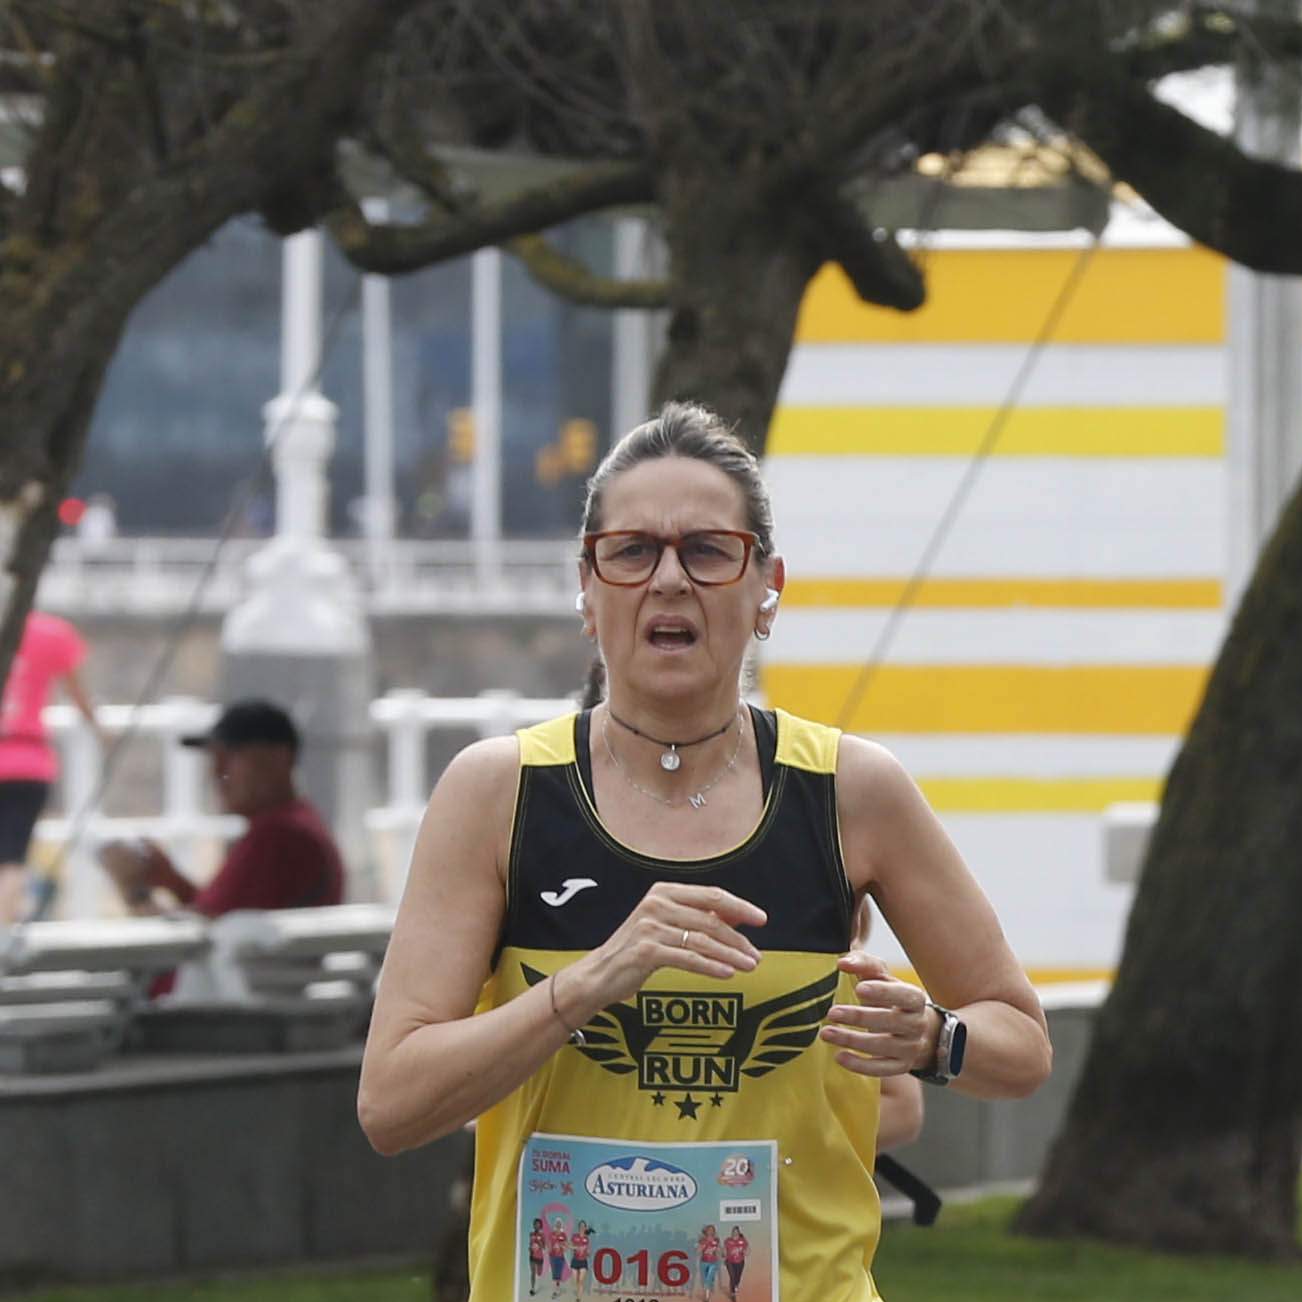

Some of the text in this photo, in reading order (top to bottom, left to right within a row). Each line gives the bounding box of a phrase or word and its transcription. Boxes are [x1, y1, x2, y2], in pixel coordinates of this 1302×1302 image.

[646, 999, 736, 1026] BORN
[648, 1056, 733, 1085] RUN
[532, 1159, 571, 1174] SUMA
[724, 1158, 749, 1176] 20
[592, 1174, 689, 1199] ASTURIANA
[593, 1247, 690, 1287] 016
